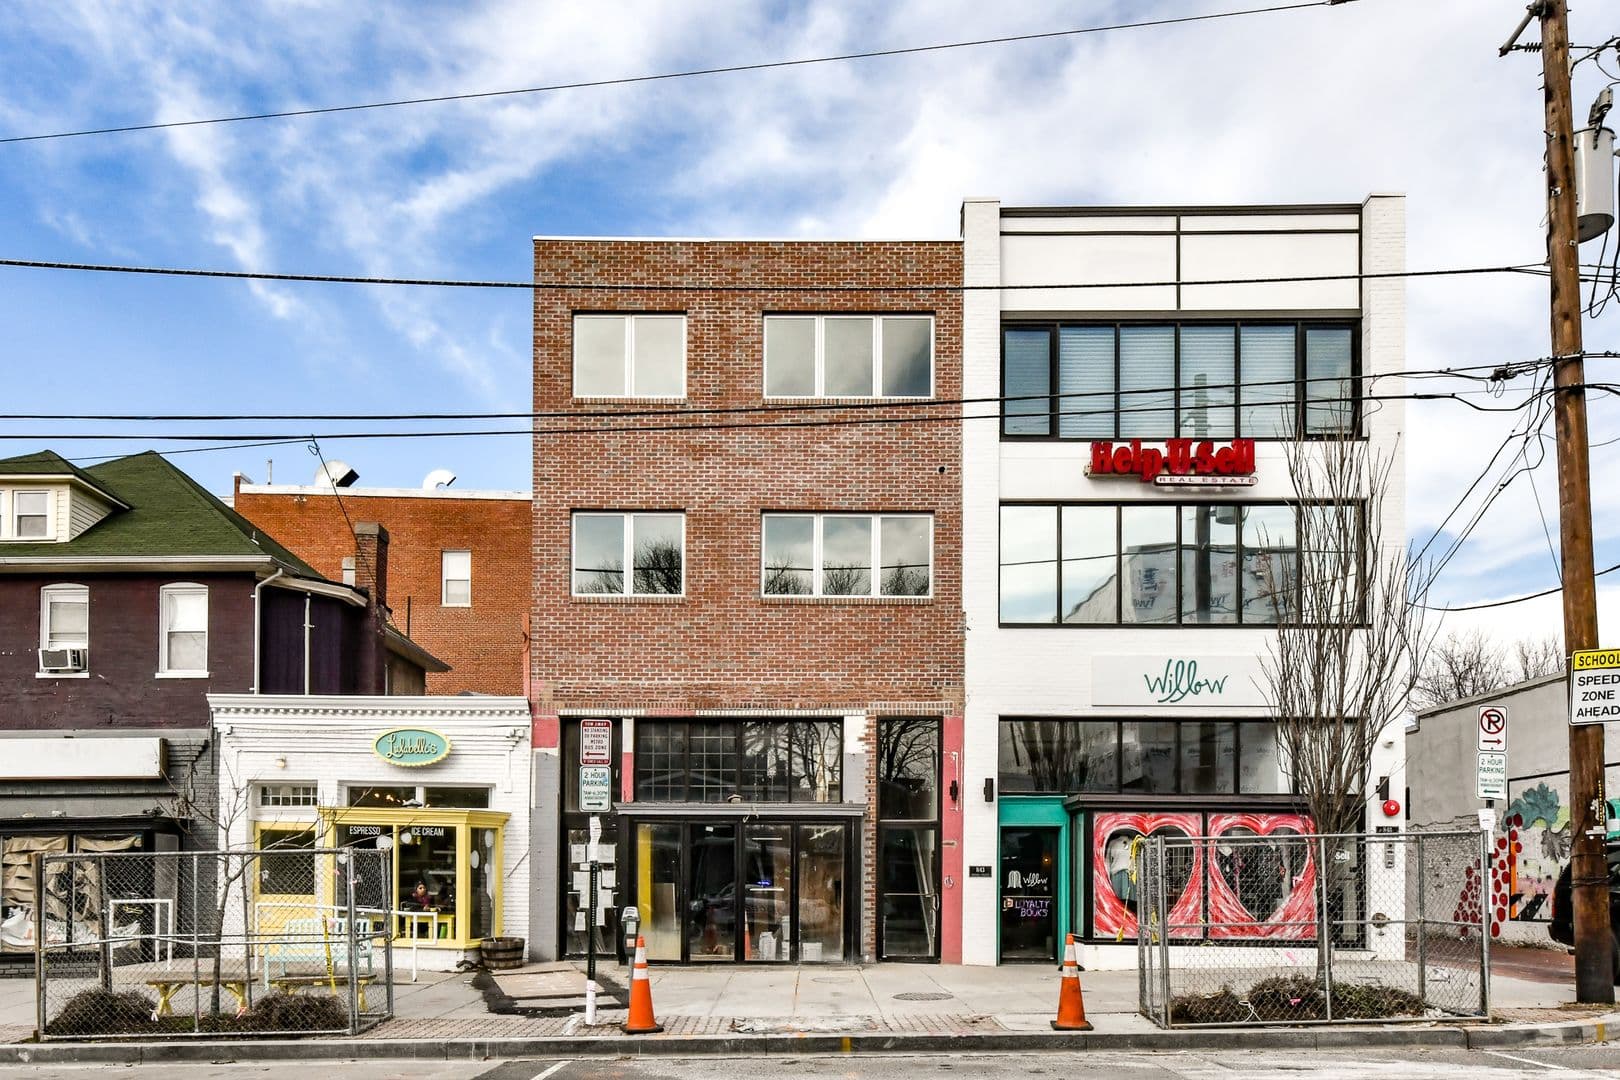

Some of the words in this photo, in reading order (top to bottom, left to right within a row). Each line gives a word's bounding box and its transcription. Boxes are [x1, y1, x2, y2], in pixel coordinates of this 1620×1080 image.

[1090, 438, 1256, 481] Help-U-Sell
[1578, 653, 1620, 667] SCHOOL
[1143, 658, 1229, 703] Willow
[1577, 674, 1620, 687] SPEED
[1581, 690, 1615, 702] ZONE
[1576, 705, 1620, 718] AHEAD
[1479, 766, 1505, 774] PARKING
[582, 779, 608, 787] PARKING
[349, 825, 381, 835] ESPRESSO
[411, 827, 421, 836] ICE
[422, 827, 444, 836] CREAM
[1022, 872, 1049, 887] Willow
[1015, 900, 1050, 909] LOYALTY
[1020, 908, 1049, 917] BOOKS
